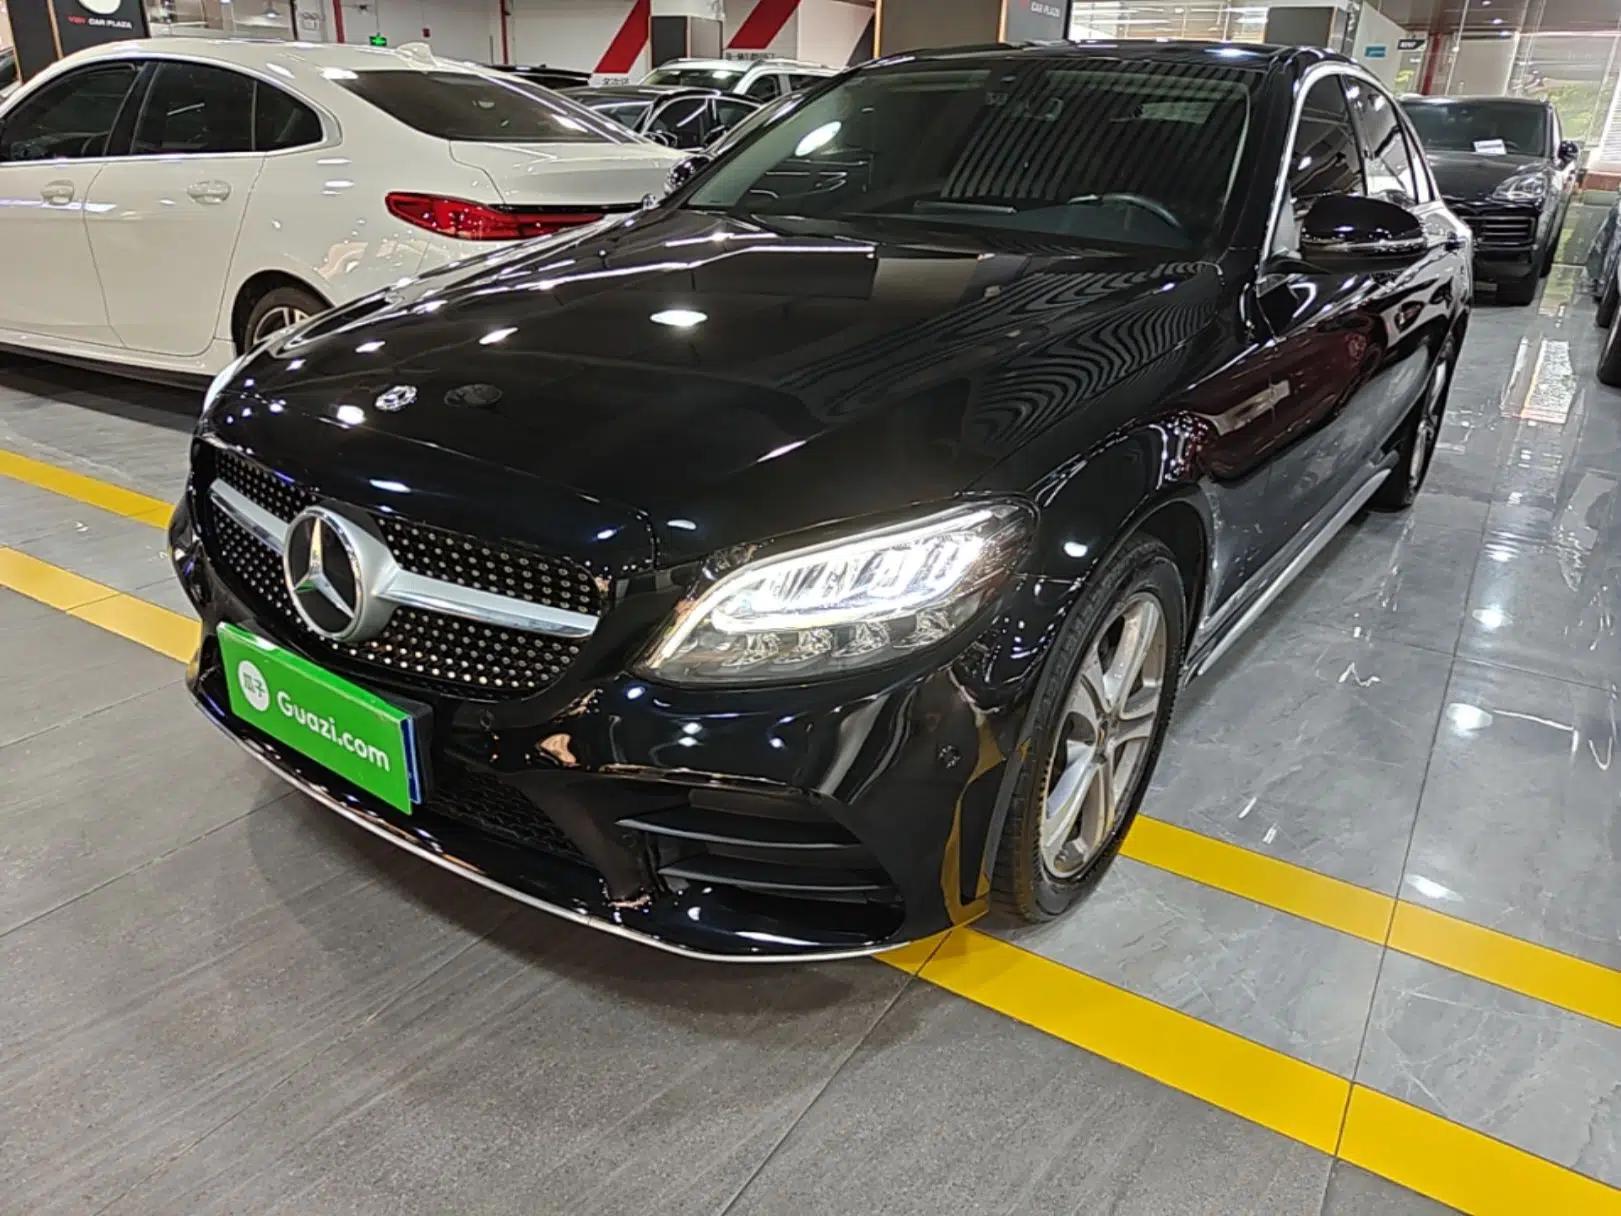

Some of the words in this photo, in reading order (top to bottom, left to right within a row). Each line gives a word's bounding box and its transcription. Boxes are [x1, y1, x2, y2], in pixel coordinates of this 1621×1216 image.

[88, 18, 105, 26] CAR
[106, 20, 133, 30] PLAZA
[276, 690, 391, 773] Guazi.com
